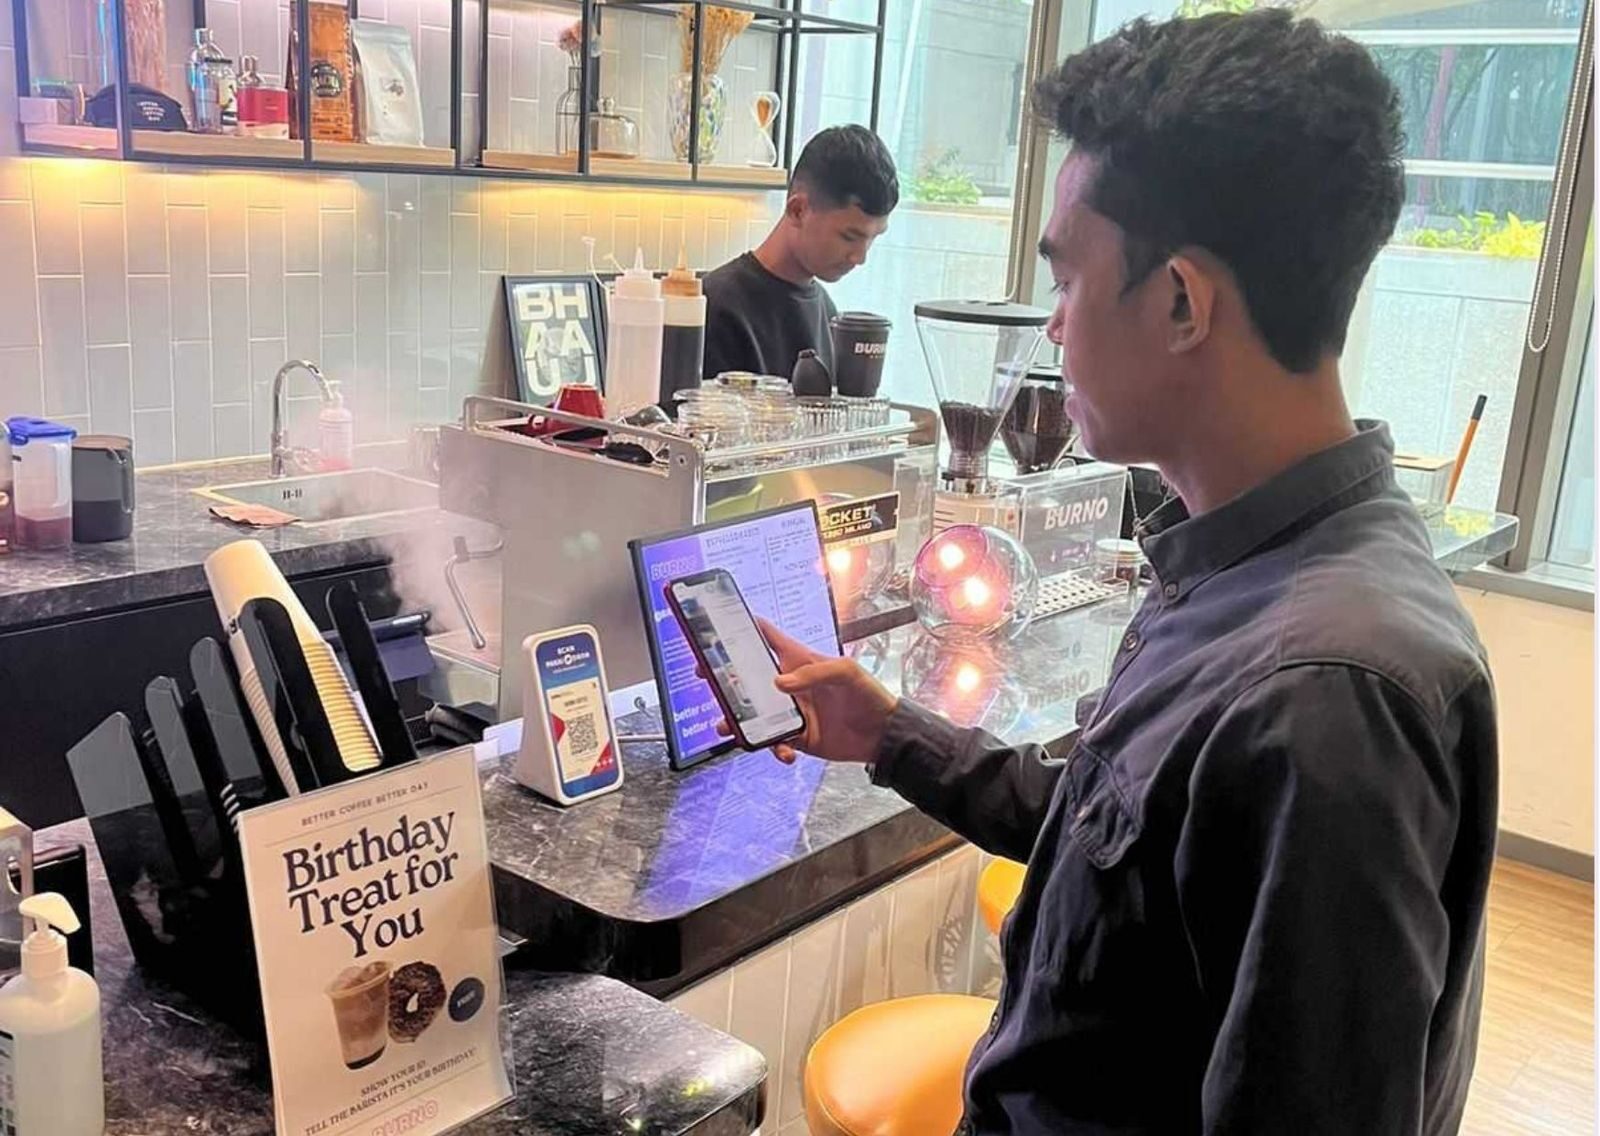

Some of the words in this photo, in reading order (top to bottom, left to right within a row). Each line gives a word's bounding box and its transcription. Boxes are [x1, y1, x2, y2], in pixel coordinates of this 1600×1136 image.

[515, 283, 588, 320] BH
[525, 320, 594, 359] AA
[820, 505, 873, 528] OCKET
[1044, 497, 1108, 530] BURNO
[301, 810, 336, 826] BETTER
[339, 799, 373, 815] COFFEE
[376, 788, 408, 804] BETTER
[410, 781, 429, 793] DAY
[282, 811, 455, 892] Birthday
[289, 869, 402, 933] Treat
[405, 852, 459, 895] for
[340, 908, 424, 958] You
[361, 1074, 391, 1097] SHOW
[391, 1064, 416, 1082] YOUR
[305, 1119, 329, 1136] TELL
[330, 1108, 349, 1125] THE
[349, 1090, 389, 1116] BARISTA
[406, 1069, 431, 1088] YOUR
